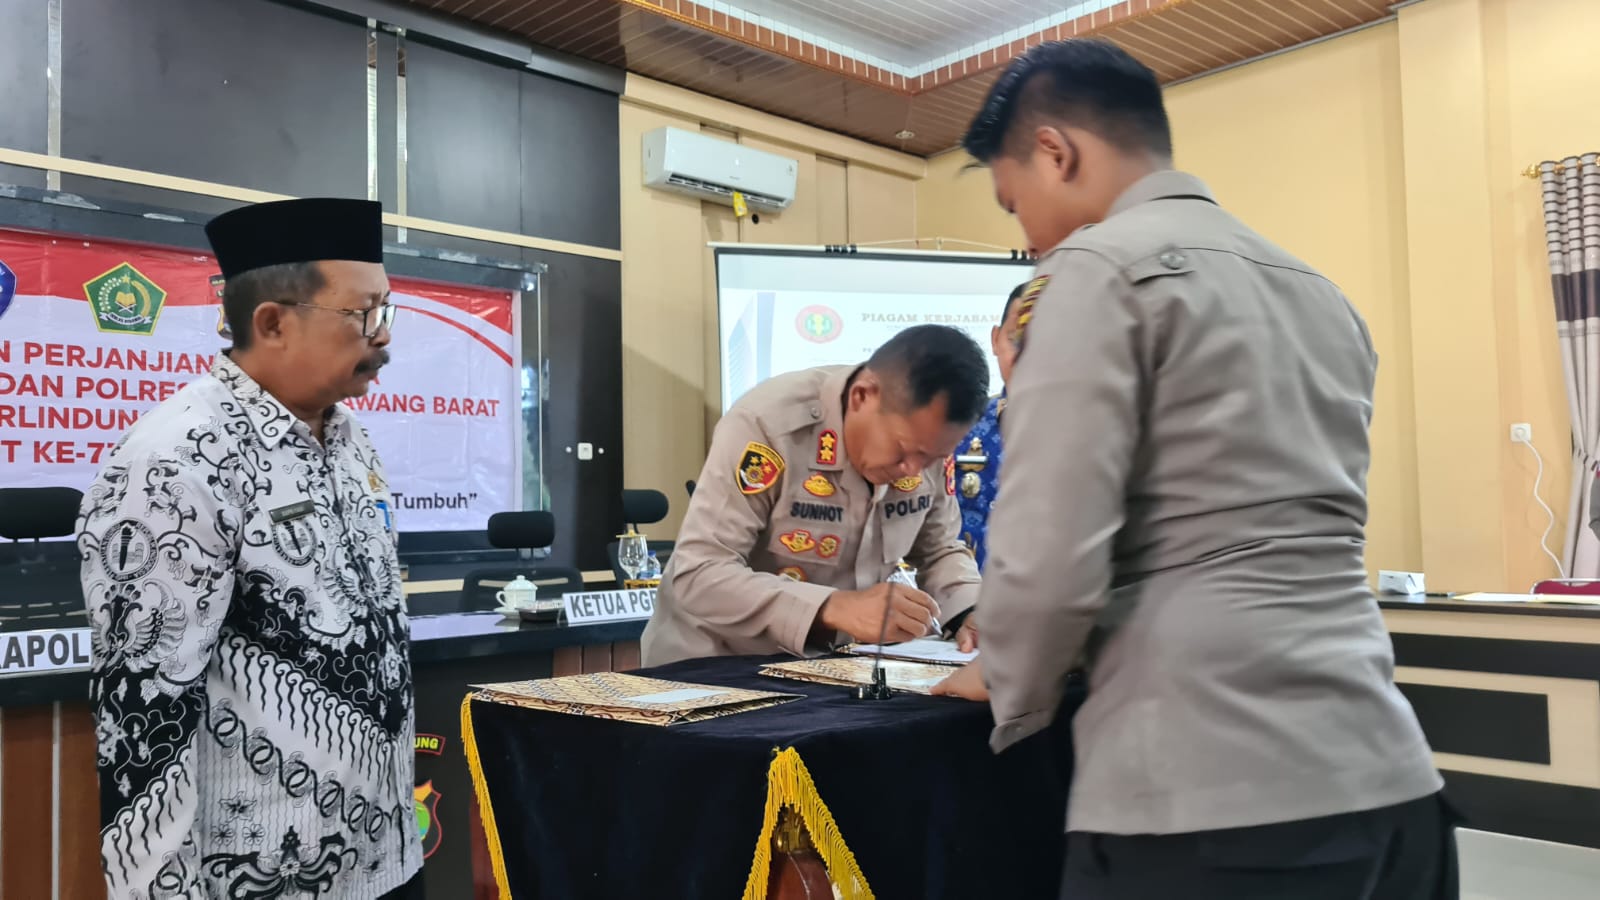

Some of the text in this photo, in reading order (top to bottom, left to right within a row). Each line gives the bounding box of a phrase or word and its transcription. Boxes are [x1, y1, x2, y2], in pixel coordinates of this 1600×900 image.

[861, 312, 918, 323] PIAGAM
[24, 341, 214, 375] PERJANJIAN
[0, 372, 188, 402] DAN POLRE
[0, 404, 148, 431] RLINDUN
[433, 396, 500, 417] BARAT
[33, 440, 115, 464] KE-7
[790, 502, 844, 523] SUNHOT
[884, 494, 931, 519] POLRI
[570, 592, 627, 618] KETUA
[0, 632, 89, 669] APOL
